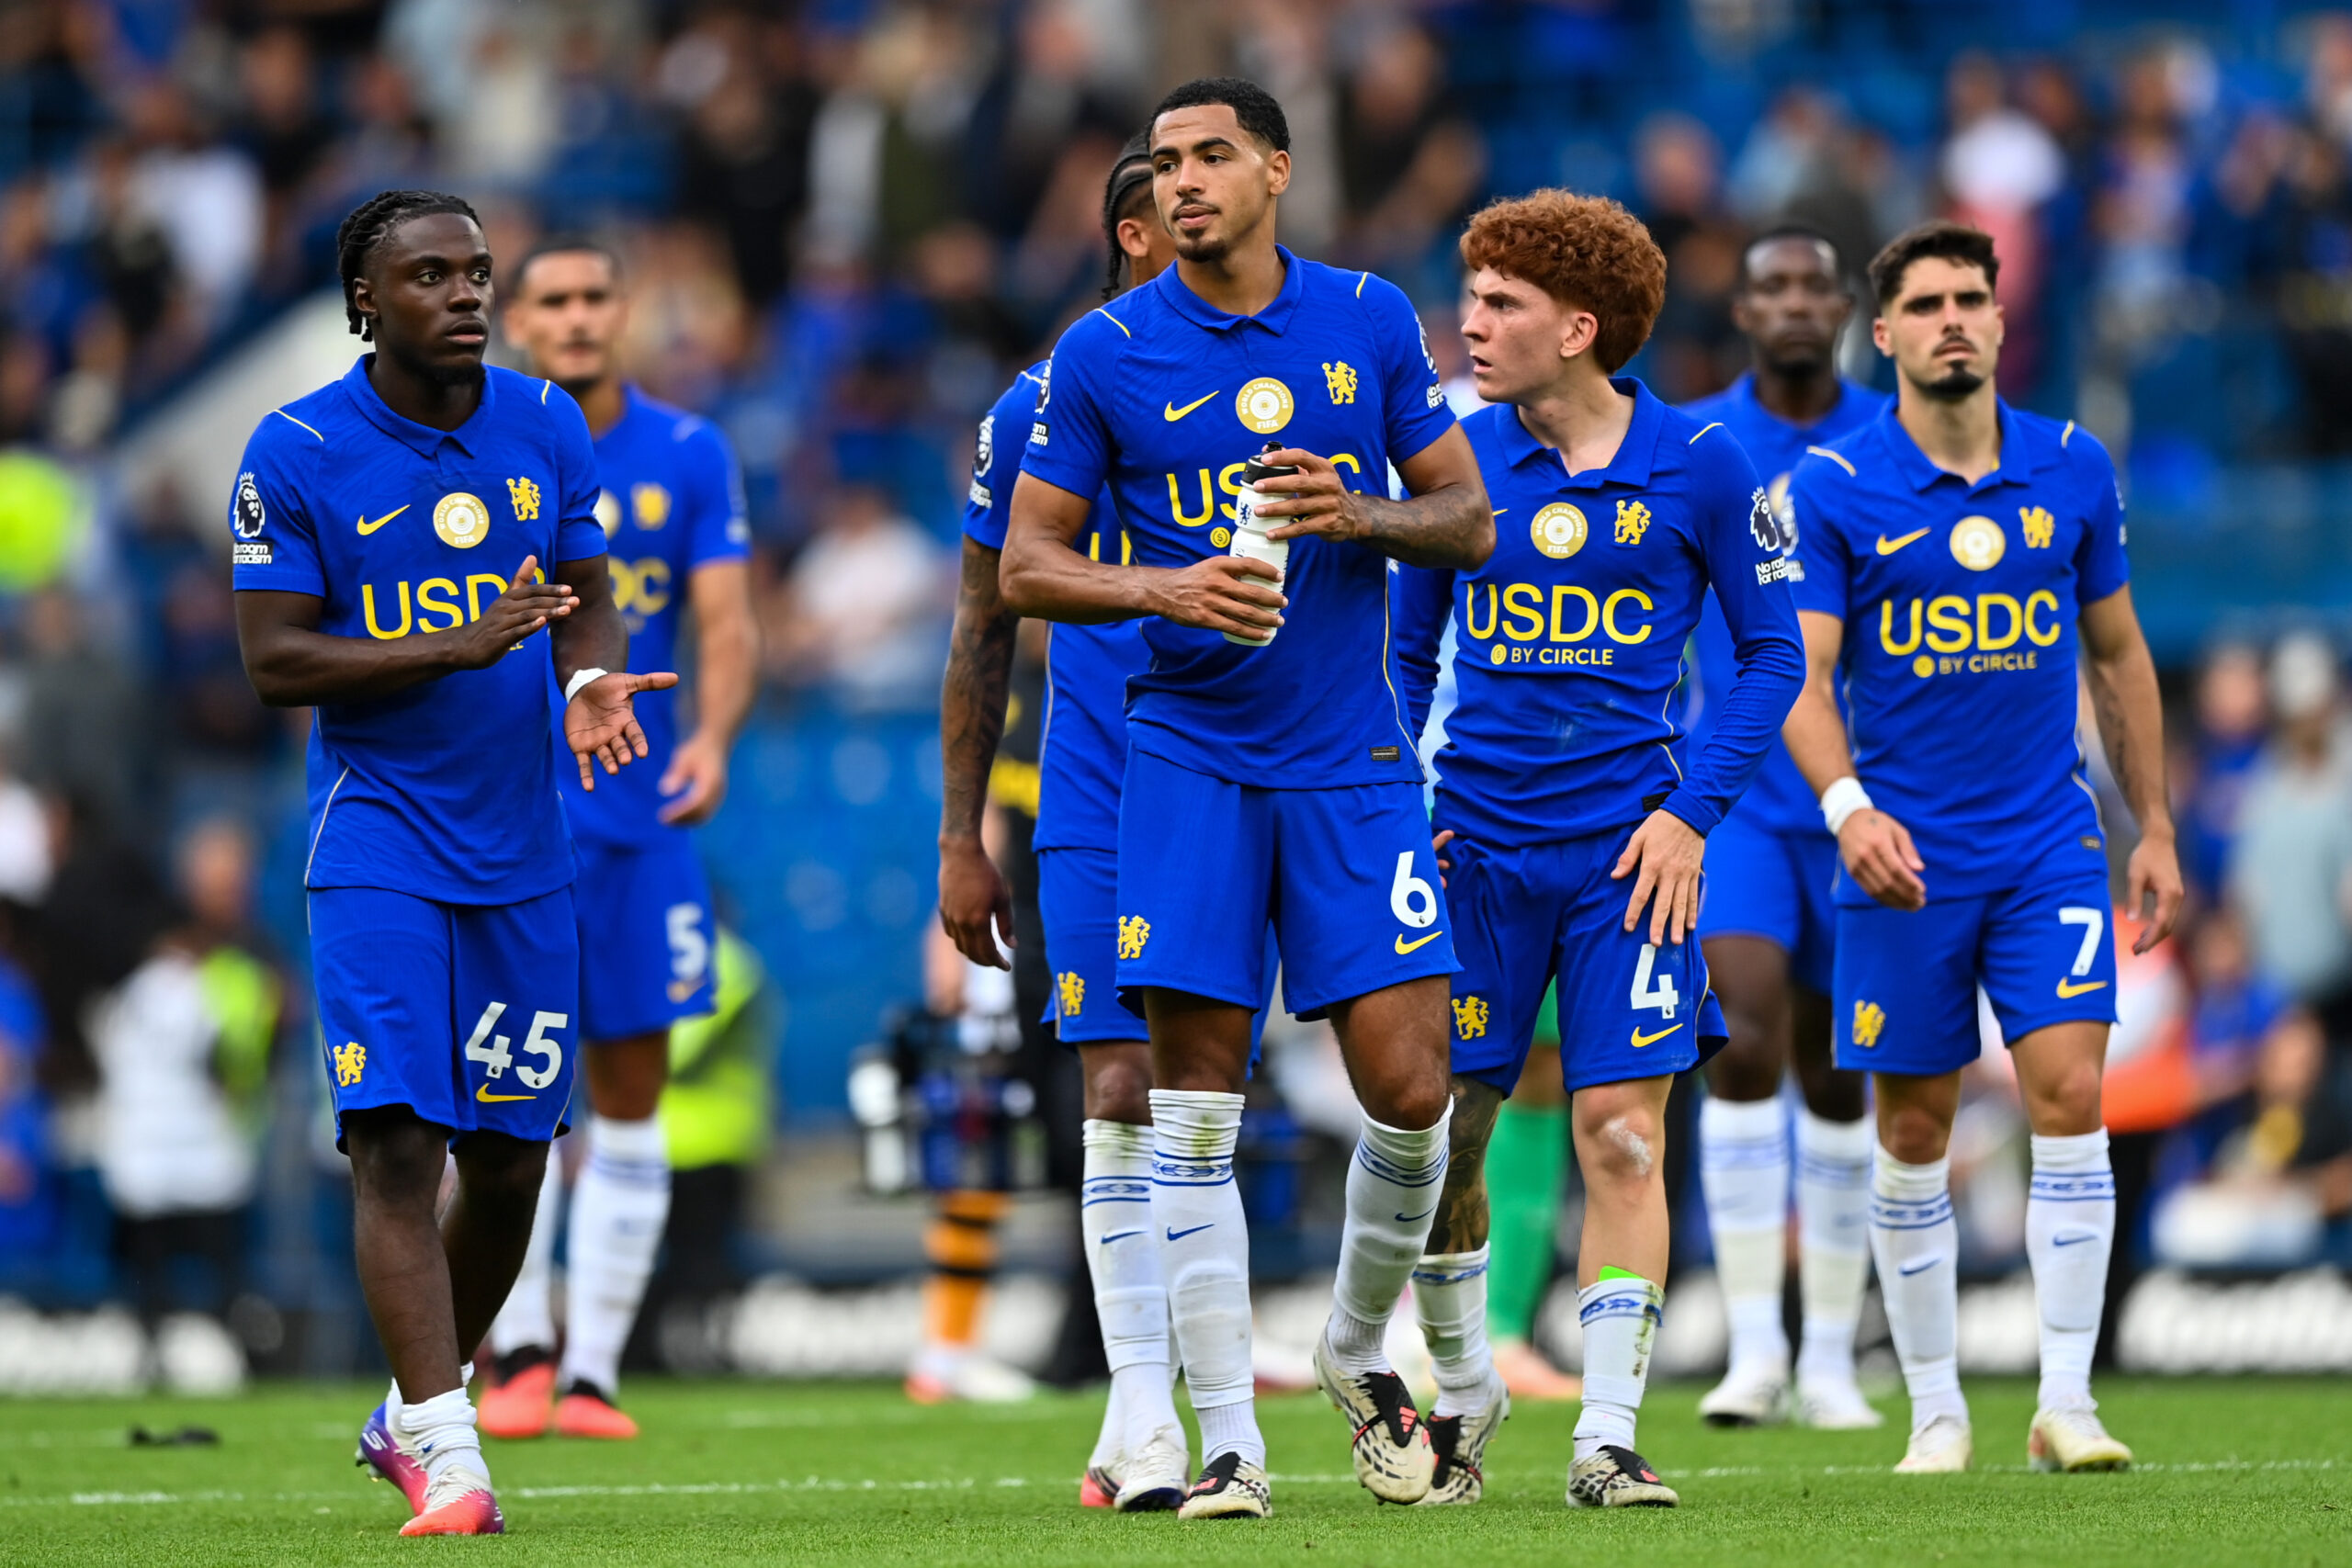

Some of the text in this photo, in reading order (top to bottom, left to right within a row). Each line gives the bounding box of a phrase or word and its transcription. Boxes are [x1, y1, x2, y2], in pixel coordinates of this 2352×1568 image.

[1241, 382, 1288, 415] WORLD CHAMPIONS
[1256, 419, 1279, 430] FIFA
[454, 536, 476, 545] FIFA
[1535, 511, 1551, 536] WORLD
[1547, 546, 1569, 554] FIFA
[1756, 562, 1771, 576] No
[362, 567, 546, 640] USD
[1467, 582, 1654, 645] USDC
[1880, 589, 2061, 656] USDC
[1511, 648, 1614, 665] BY CIRCLE
[1939, 650, 2037, 675] BY CIRCLE
[1390, 851, 1438, 929] 6
[665, 902, 707, 980] 5
[2058, 907, 2104, 976] 7
[1631, 943, 1679, 1020] 4
[465, 1001, 568, 1089] 45
